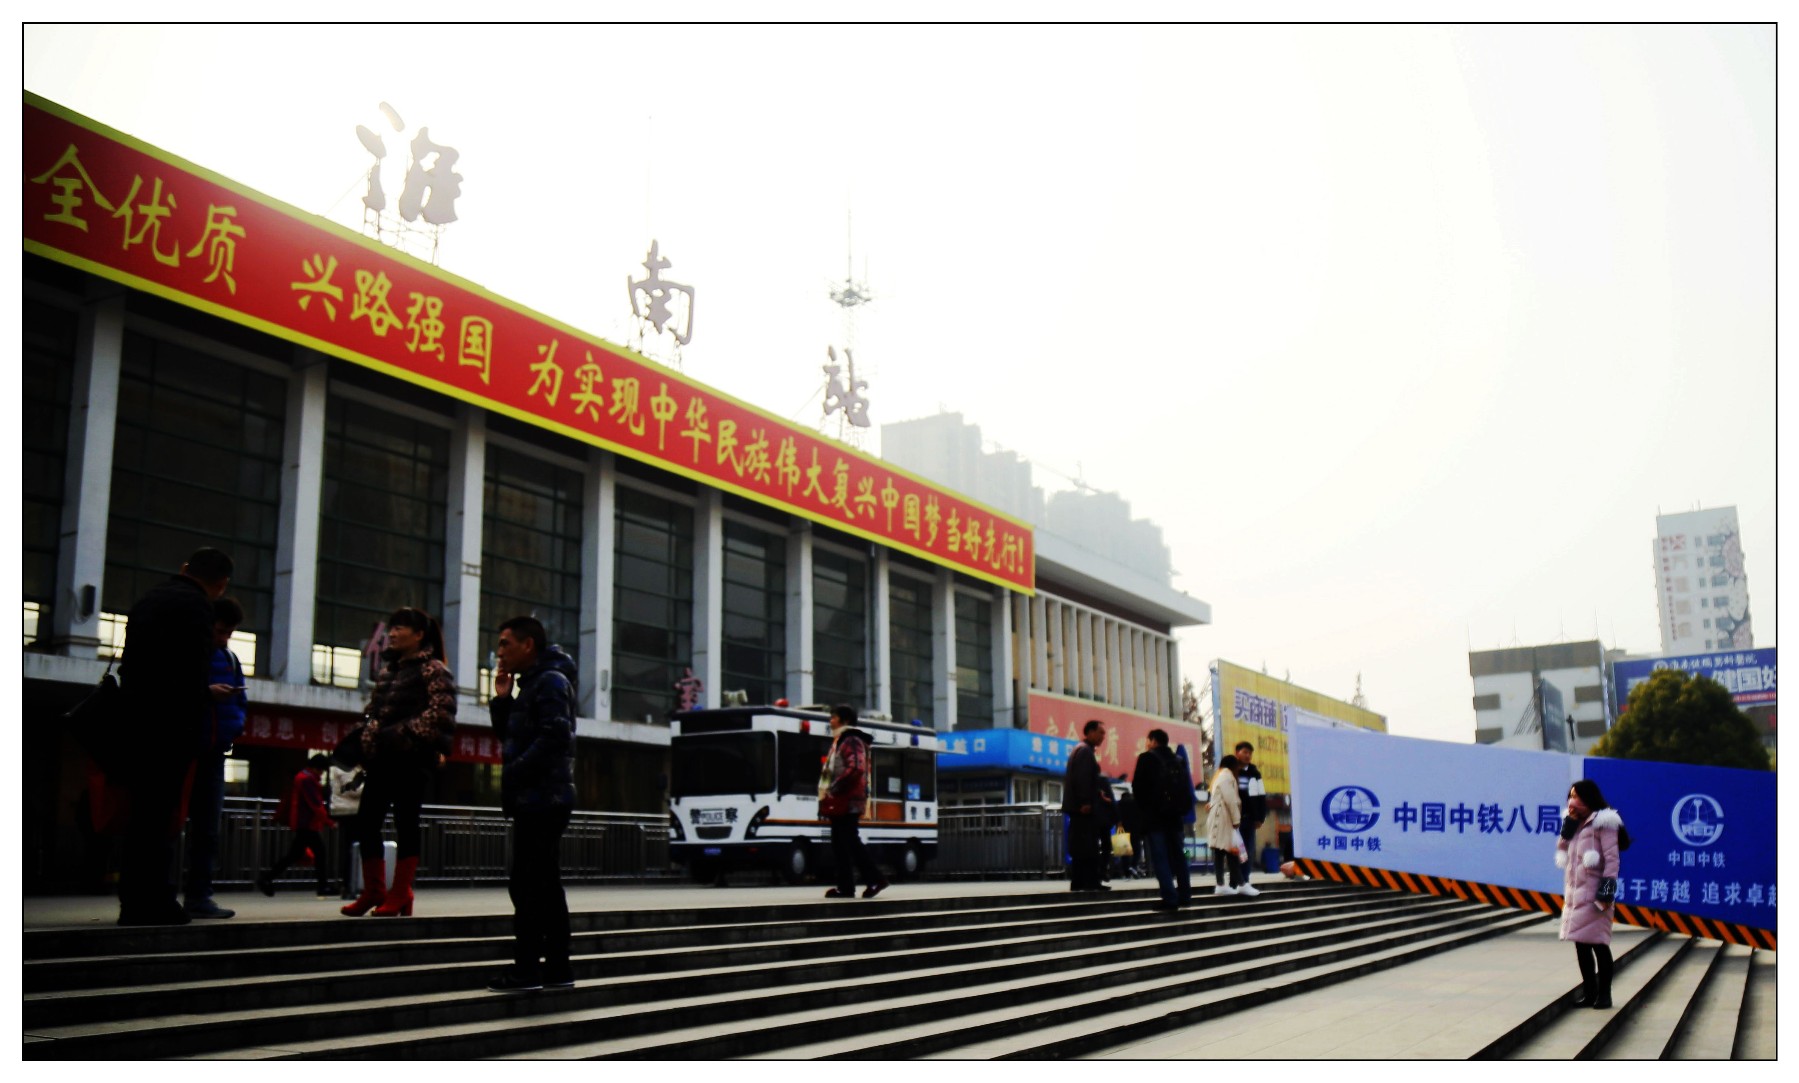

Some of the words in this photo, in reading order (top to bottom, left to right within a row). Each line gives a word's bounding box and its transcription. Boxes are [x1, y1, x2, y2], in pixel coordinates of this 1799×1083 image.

[290, 252, 494, 385] 兴路强国
[460, 736, 503, 758] 构建
[1393, 801, 1561, 836] 中国中铁八局
[1317, 835, 1382, 852] 中国中铁
[1668, 850, 1726, 869] 中国中铁
